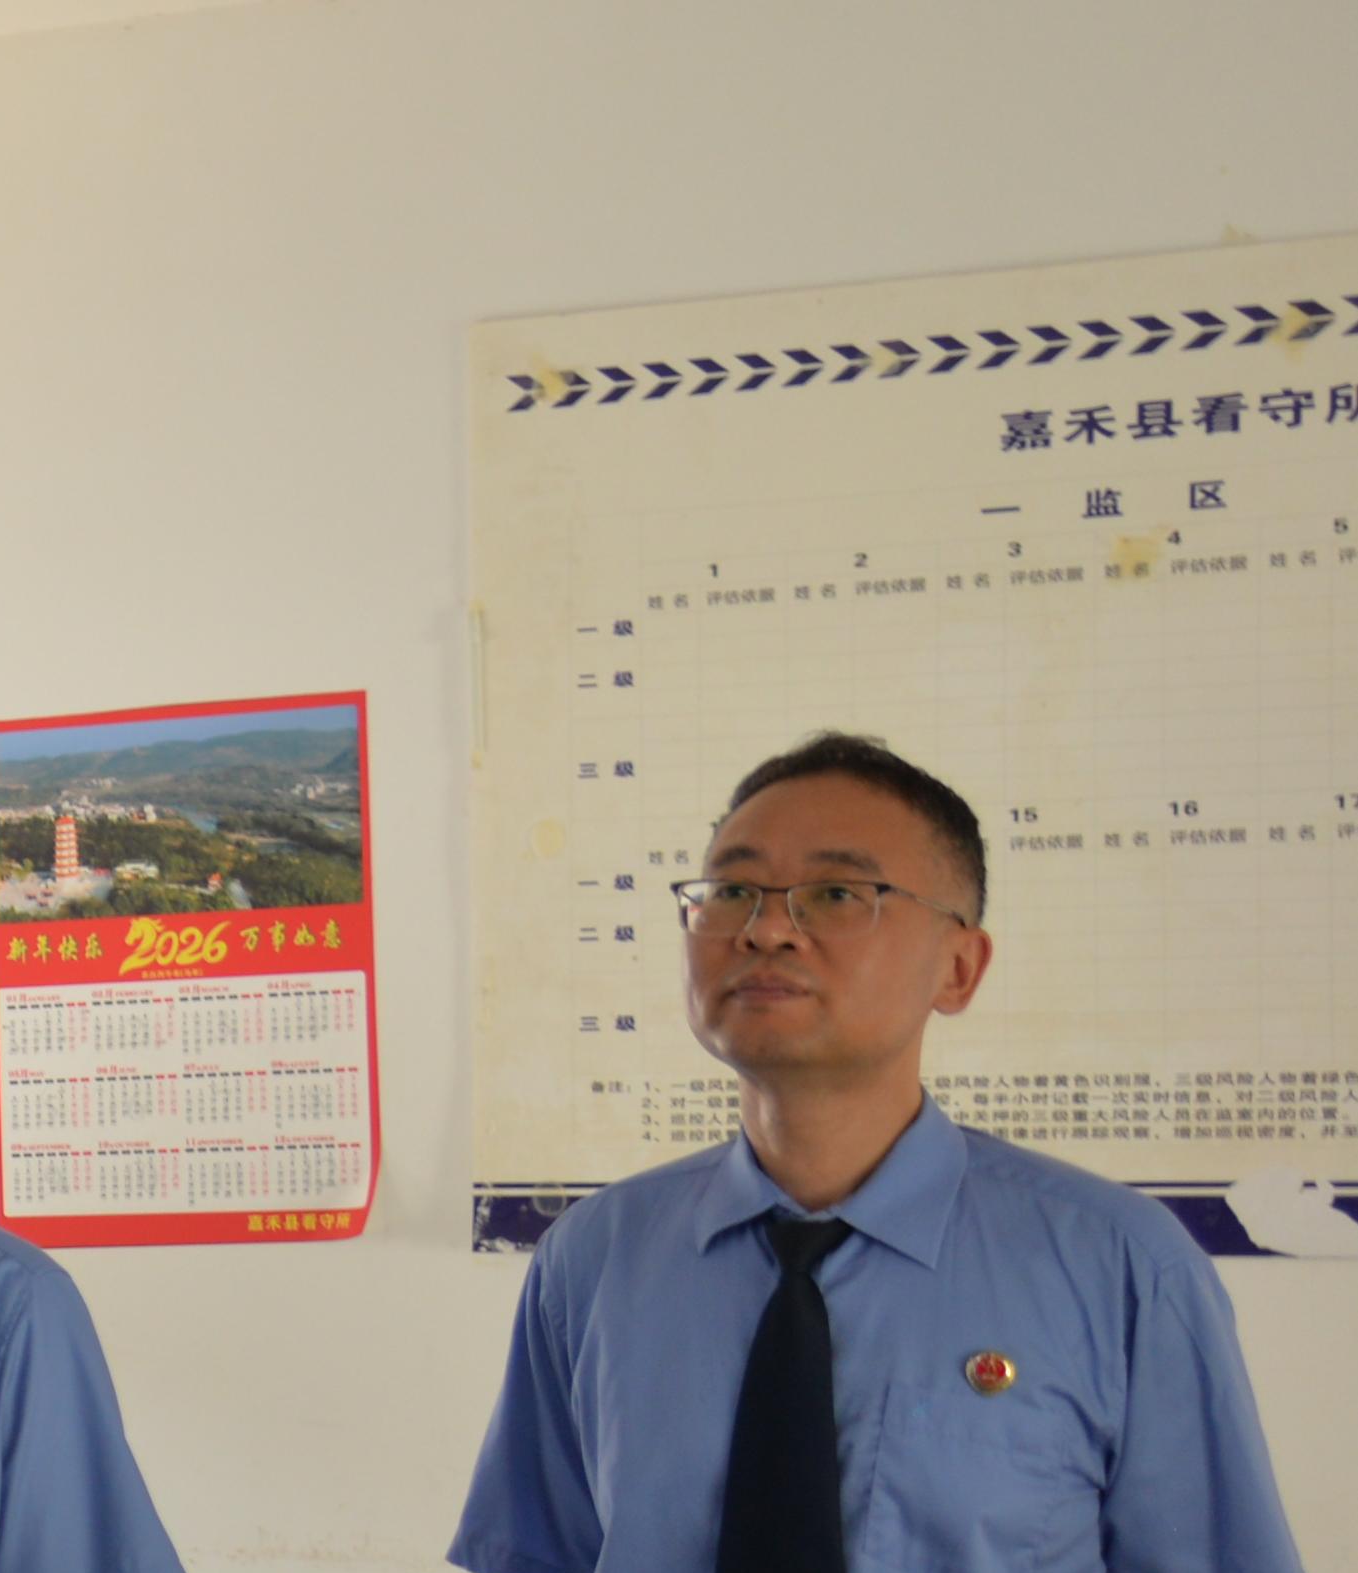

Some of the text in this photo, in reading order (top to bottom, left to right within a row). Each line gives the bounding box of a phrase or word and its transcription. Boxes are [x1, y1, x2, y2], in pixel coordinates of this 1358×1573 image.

[1000, 383, 1358, 451] 嘉禾县看守所
[1334, 517, 1348, 534] 5
[1167, 530, 1181, 546] 4
[1008, 542, 1022, 557] 3
[854, 553, 868, 568] 2
[709, 563, 719, 578] 1
[1010, 807, 1038, 823] 15
[1170, 801, 1199, 817] 16
[6, 916, 342, 976] 新年快乐 2026 万事如意
